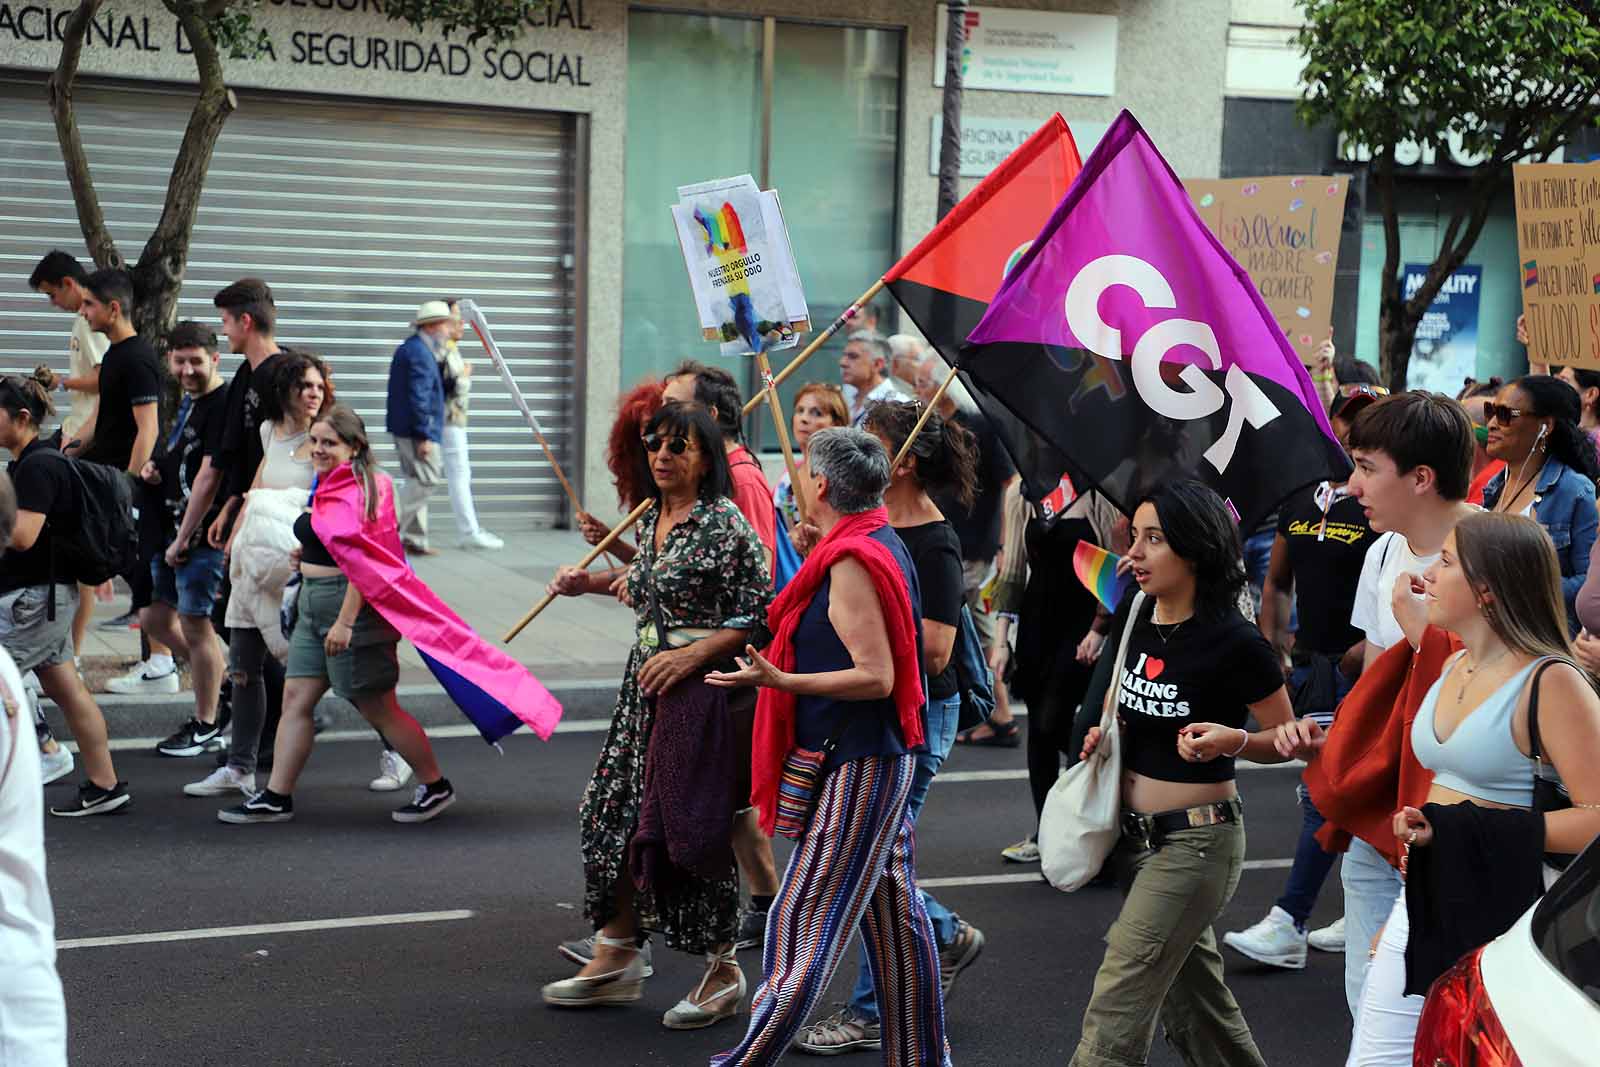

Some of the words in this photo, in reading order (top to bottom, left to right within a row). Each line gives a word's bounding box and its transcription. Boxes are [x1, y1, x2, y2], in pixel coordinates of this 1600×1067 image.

[291, 31, 470, 76] SEGURIDAD
[484, 47, 591, 87] SOCIAL
[1564, 218, 1575, 248] DE
[707, 262, 730, 279] NUESTRO
[731, 252, 761, 271] ORGULLO
[735, 269, 744, 281] SU
[744, 264, 763, 278] ODIO
[1248, 249, 1306, 274] MADRE
[1259, 275, 1314, 303] COMER
[1536, 264, 1562, 297] HACEN
[1528, 303, 1549, 359] TU
[1551, 303, 1581, 361] ODIO
[1065, 254, 1282, 476] CGT
[1132, 652, 1148, 675] I
